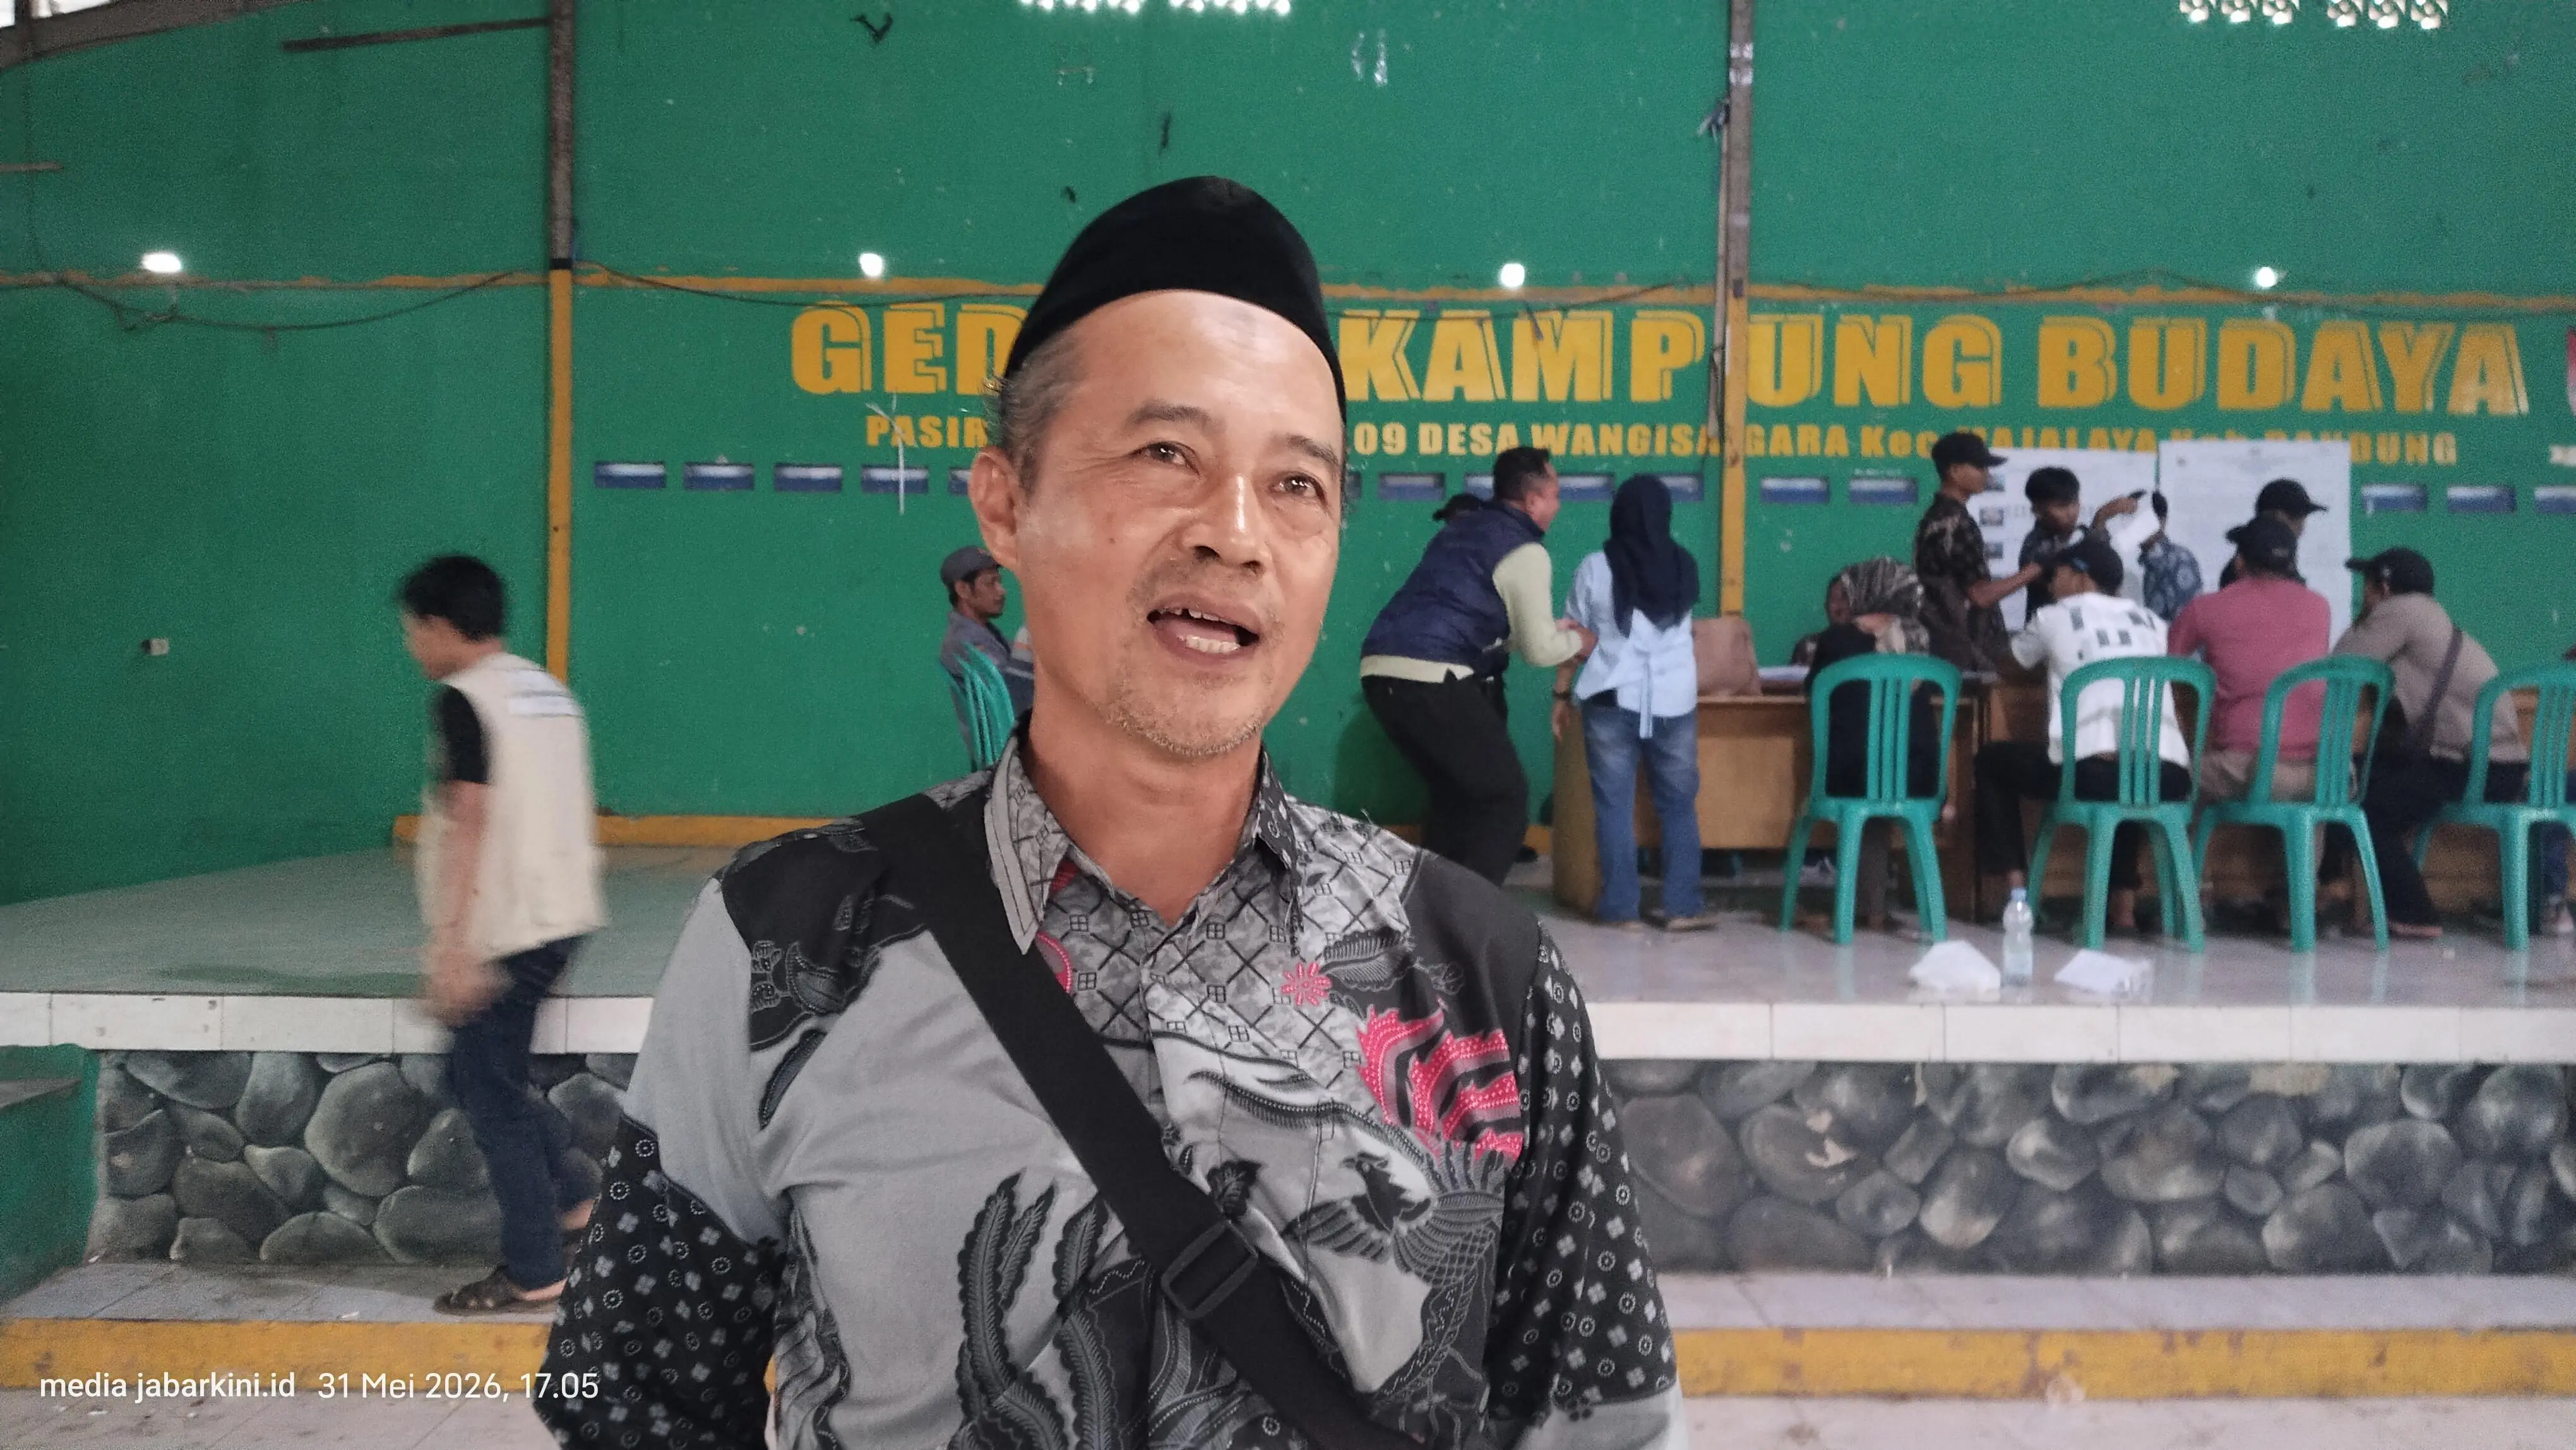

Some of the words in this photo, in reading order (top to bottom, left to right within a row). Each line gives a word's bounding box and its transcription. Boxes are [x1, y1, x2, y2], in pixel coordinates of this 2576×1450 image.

[791, 300, 1030, 395] GED
[1338, 309, 2003, 410] KAMPUNG
[2037, 316, 2529, 415] BUDAYA
[1418, 422, 1519, 456] DESA
